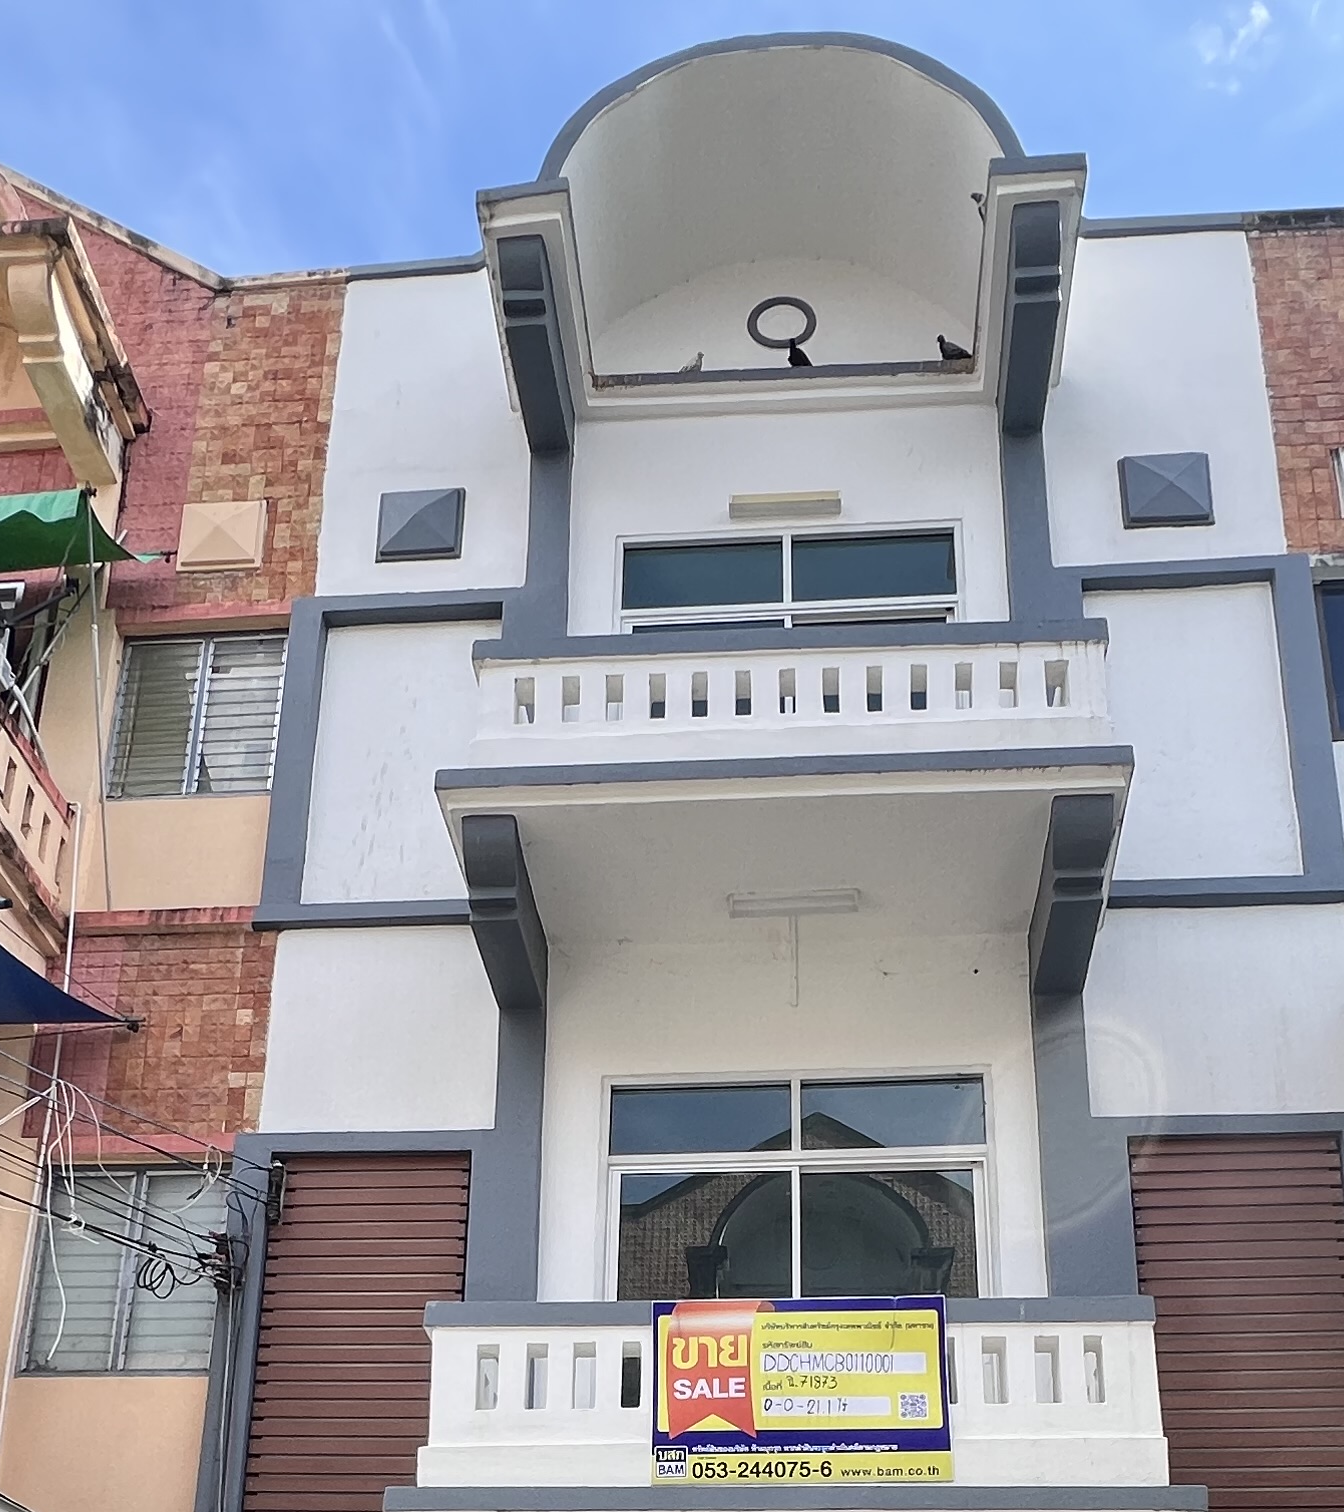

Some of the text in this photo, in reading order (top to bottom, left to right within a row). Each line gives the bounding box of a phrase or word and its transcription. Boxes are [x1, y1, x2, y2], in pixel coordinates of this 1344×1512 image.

[671, 1334, 748, 1370] ขาย
[673, 1377, 746, 1400] SALE
[657, 1450, 685, 1461] บสก
[658, 1464, 684, 1475] BAM
[692, 1461, 833, 1479] 053-244075-6
[841, 1466, 940, 1477] www.bam.co.th
